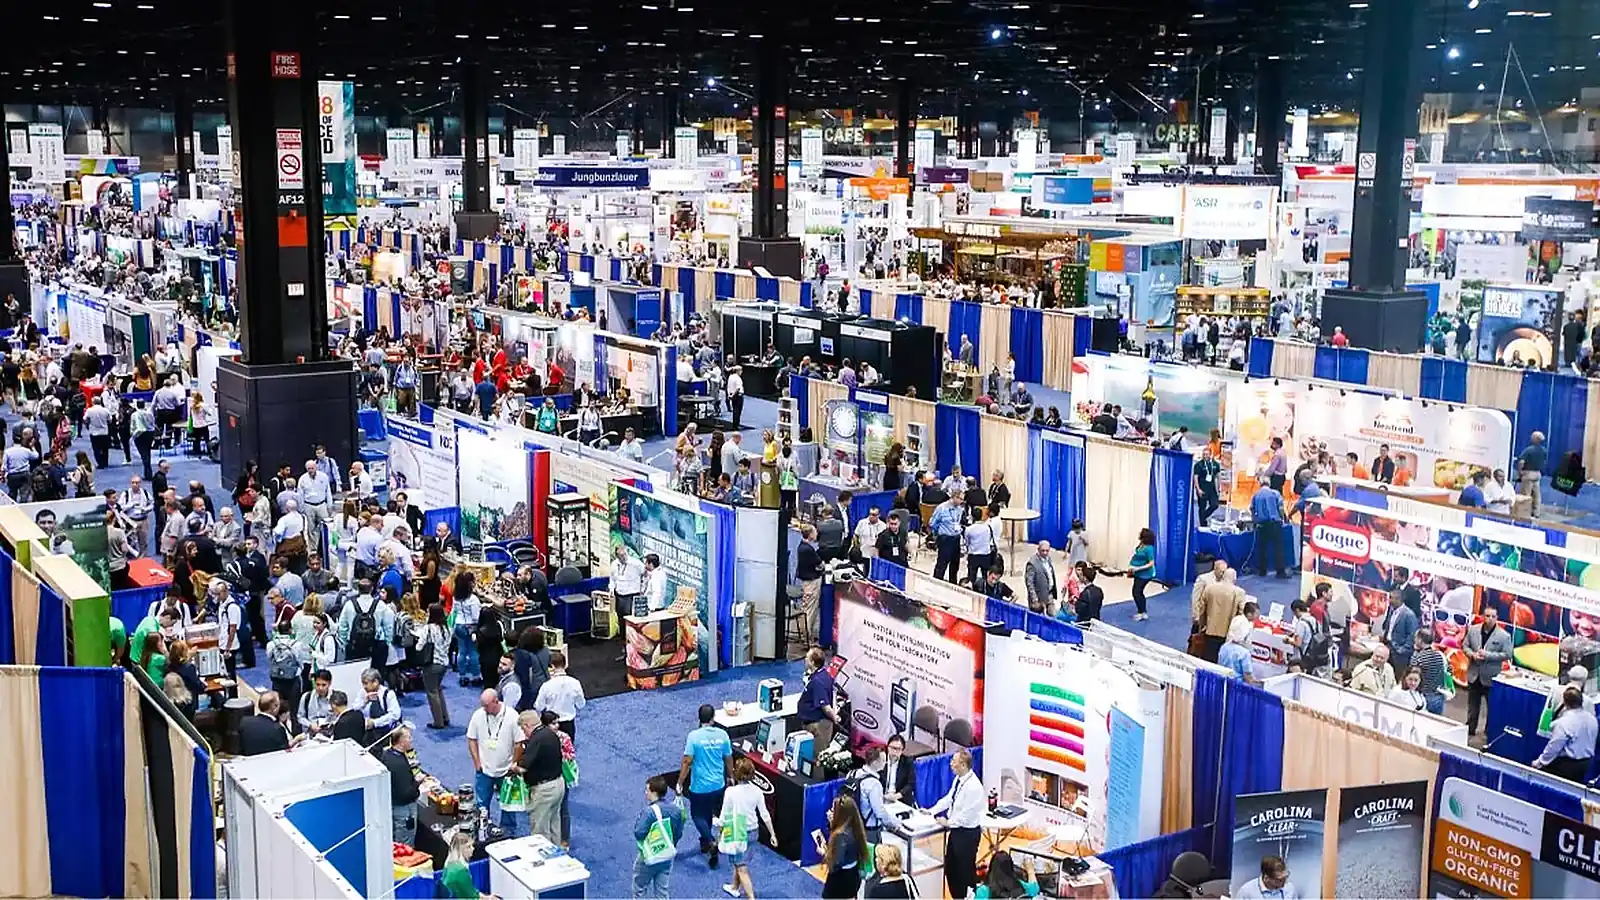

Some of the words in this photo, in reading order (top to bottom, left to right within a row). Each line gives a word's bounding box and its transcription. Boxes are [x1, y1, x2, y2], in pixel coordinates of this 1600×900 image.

[275, 55, 295, 65] FIRE
[274, 65, 298, 75] HOSE
[824, 127, 864, 143] CAFE
[1155, 123, 1200, 142] CAFE
[571, 172, 639, 184] Jungbunzlauer
[279, 195, 305, 204] AF12
[1315, 528, 1365, 551] Jogue
[1481, 569, 1509, 583] Minority
[1510, 577, 1541, 591] Certified
[873, 632, 884, 642] FOR
[885, 639, 901, 649] YOUR
[1250, 806, 1313, 827] CAROLINA
[1353, 797, 1414, 819] CAROLINA
[1267, 821, 1295, 834] CLEAR
[1370, 811, 1398, 825] CRAFT
[1448, 830, 1522, 867] NON-GMO
[1446, 845, 1521, 881] GLUTEN-FREE
[1559, 853, 1579, 868] WITH
[1581, 862, 1596, 874] THE
[1444, 858, 1519, 896] ORGANIC
